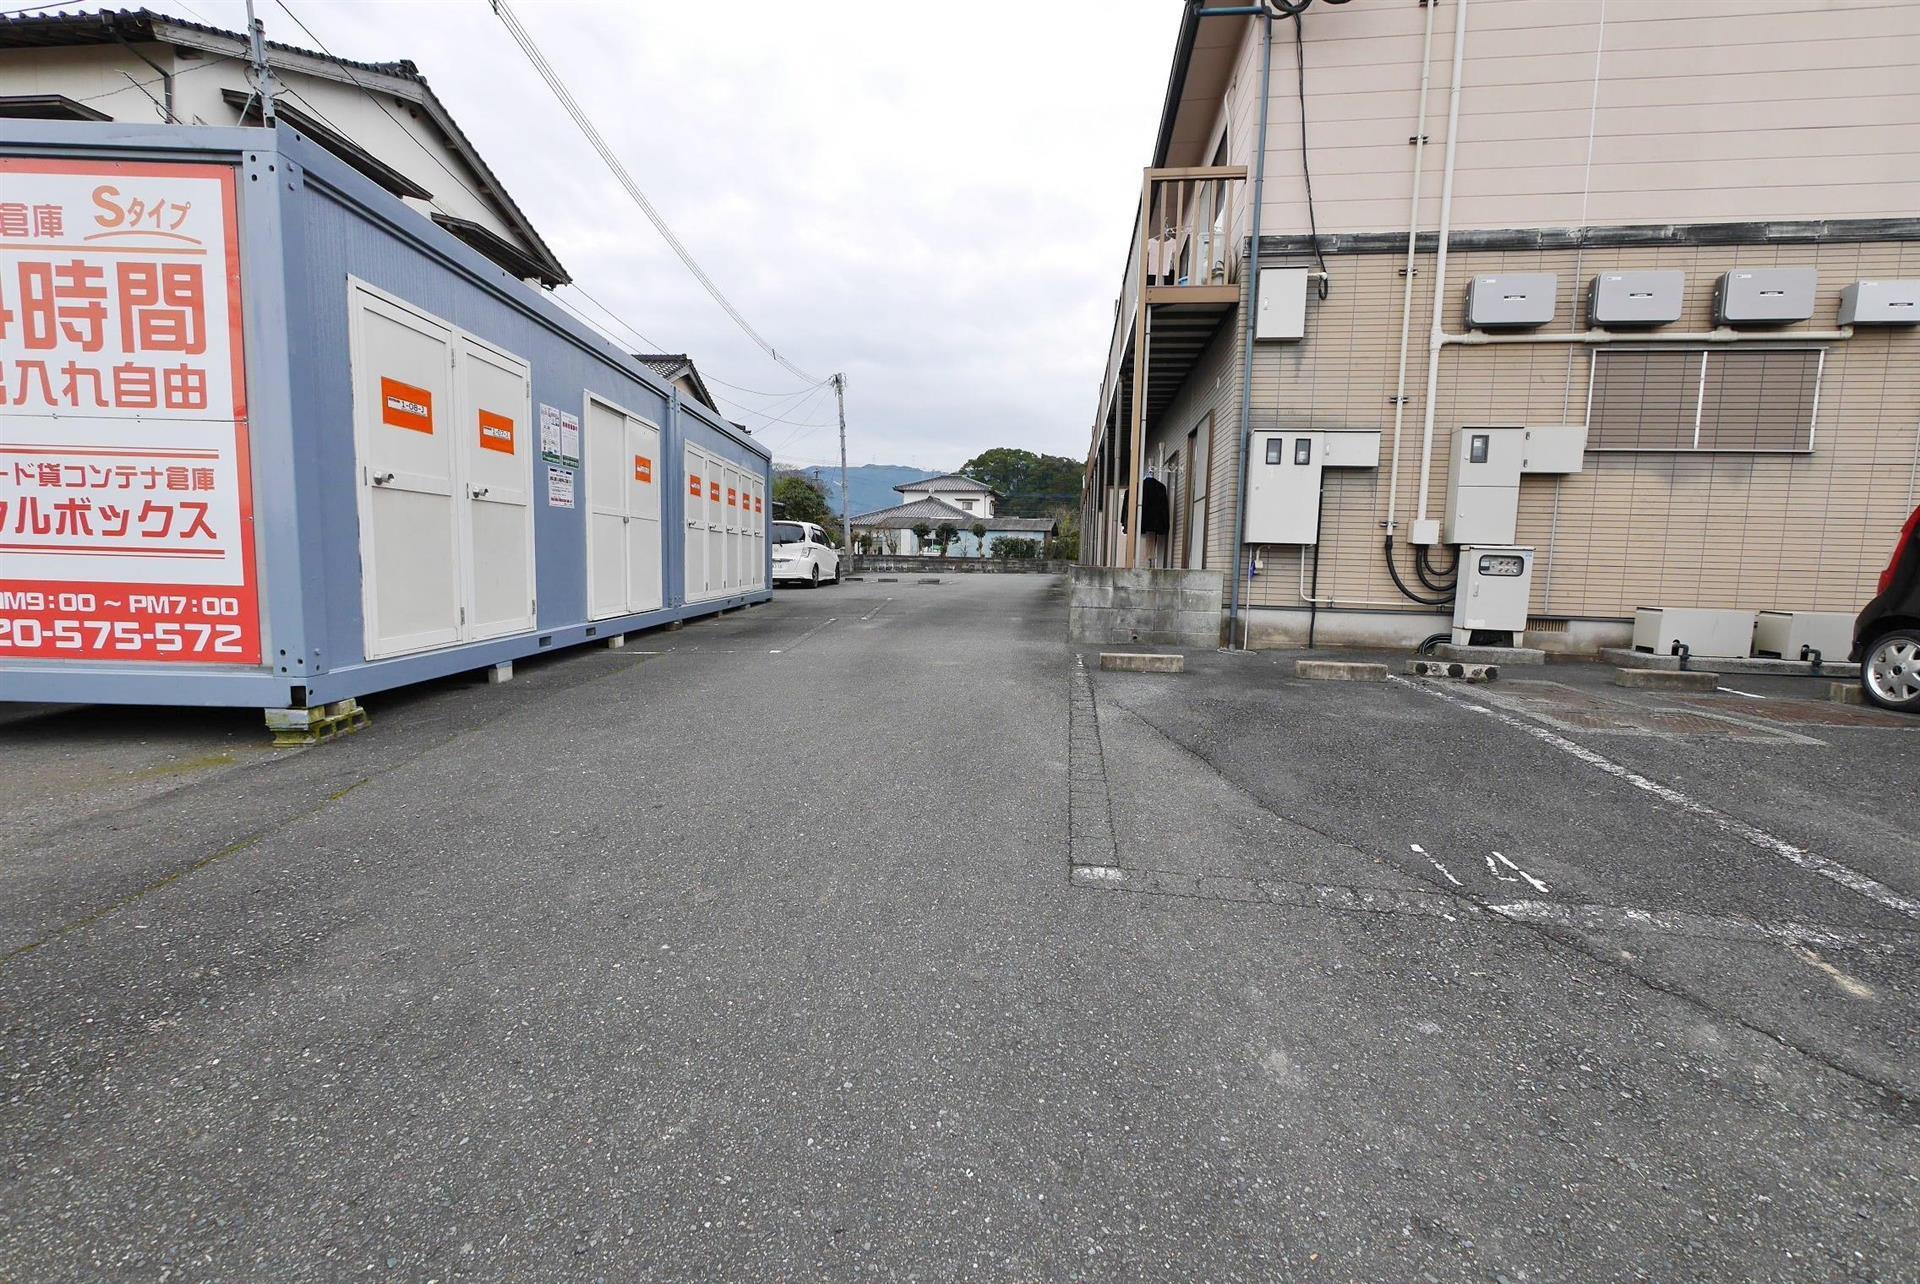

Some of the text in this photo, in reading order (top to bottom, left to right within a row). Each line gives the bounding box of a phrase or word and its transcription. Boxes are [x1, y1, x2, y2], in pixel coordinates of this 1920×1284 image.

[0, 202, 64, 238] 倉庫
[91, 184, 192, 231] Sタイプ
[0, 360, 208, 410] 入れ自由
[0, 591, 96, 613] M9:00
[129, 594, 239, 616] PM7:00
